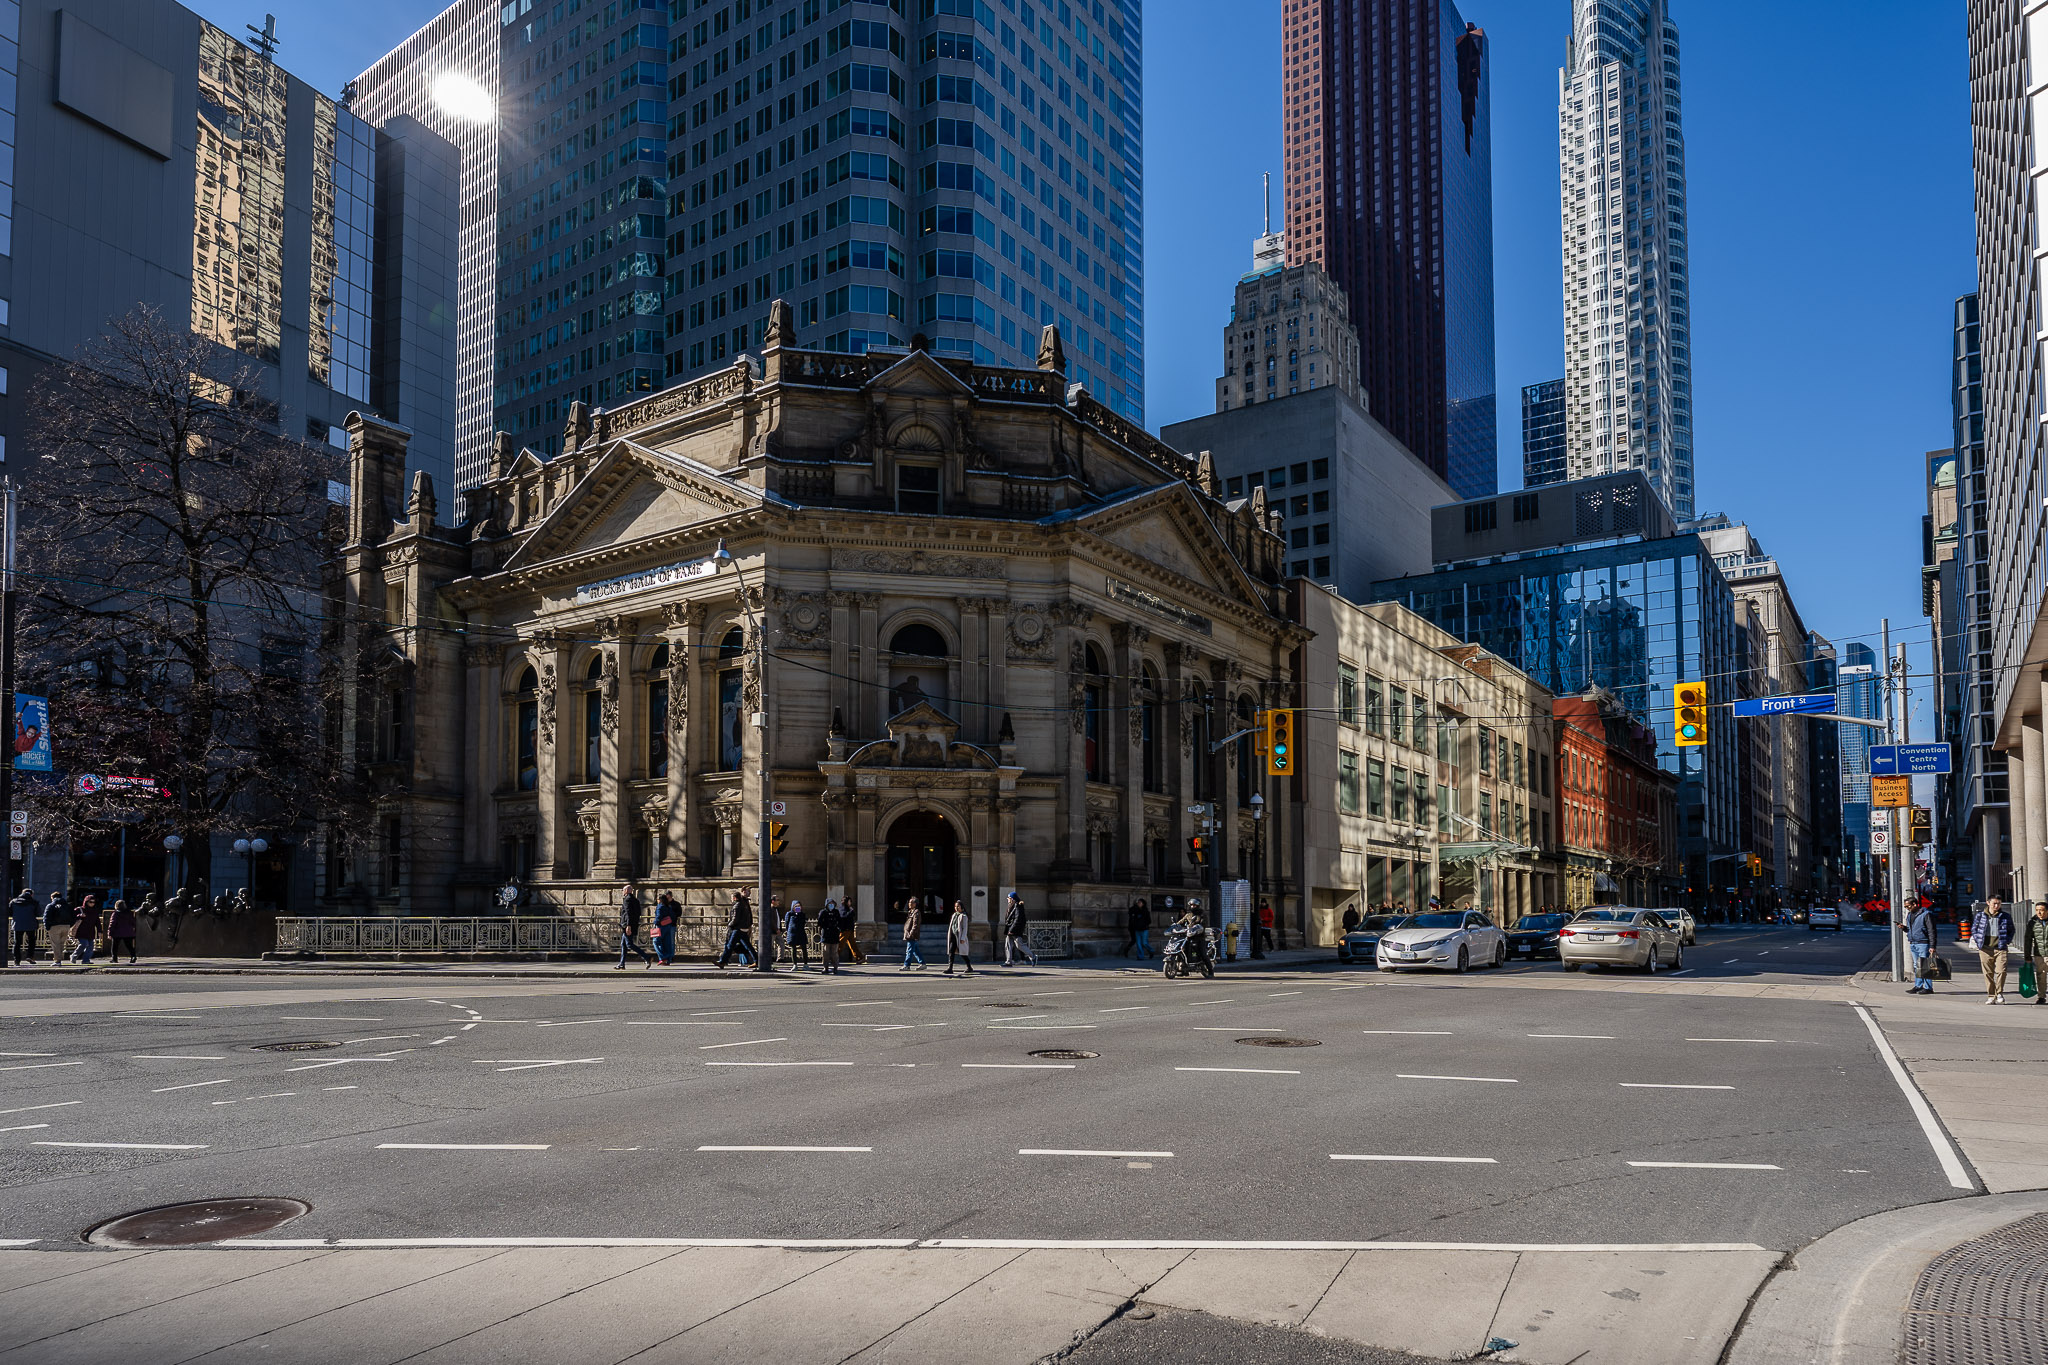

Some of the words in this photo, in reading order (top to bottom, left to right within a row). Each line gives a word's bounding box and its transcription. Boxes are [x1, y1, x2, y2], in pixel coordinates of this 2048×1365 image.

[589, 580, 627, 599] HOCKEY
[629, 575, 656, 590] HALL
[658, 569, 673, 583] OF
[674, 563, 702, 579] FAME
[36, 700, 47, 711] it
[1762, 698, 1796, 711] Front
[21, 752, 46, 761] HOCKEY
[1899, 747, 1947, 755] Convention
